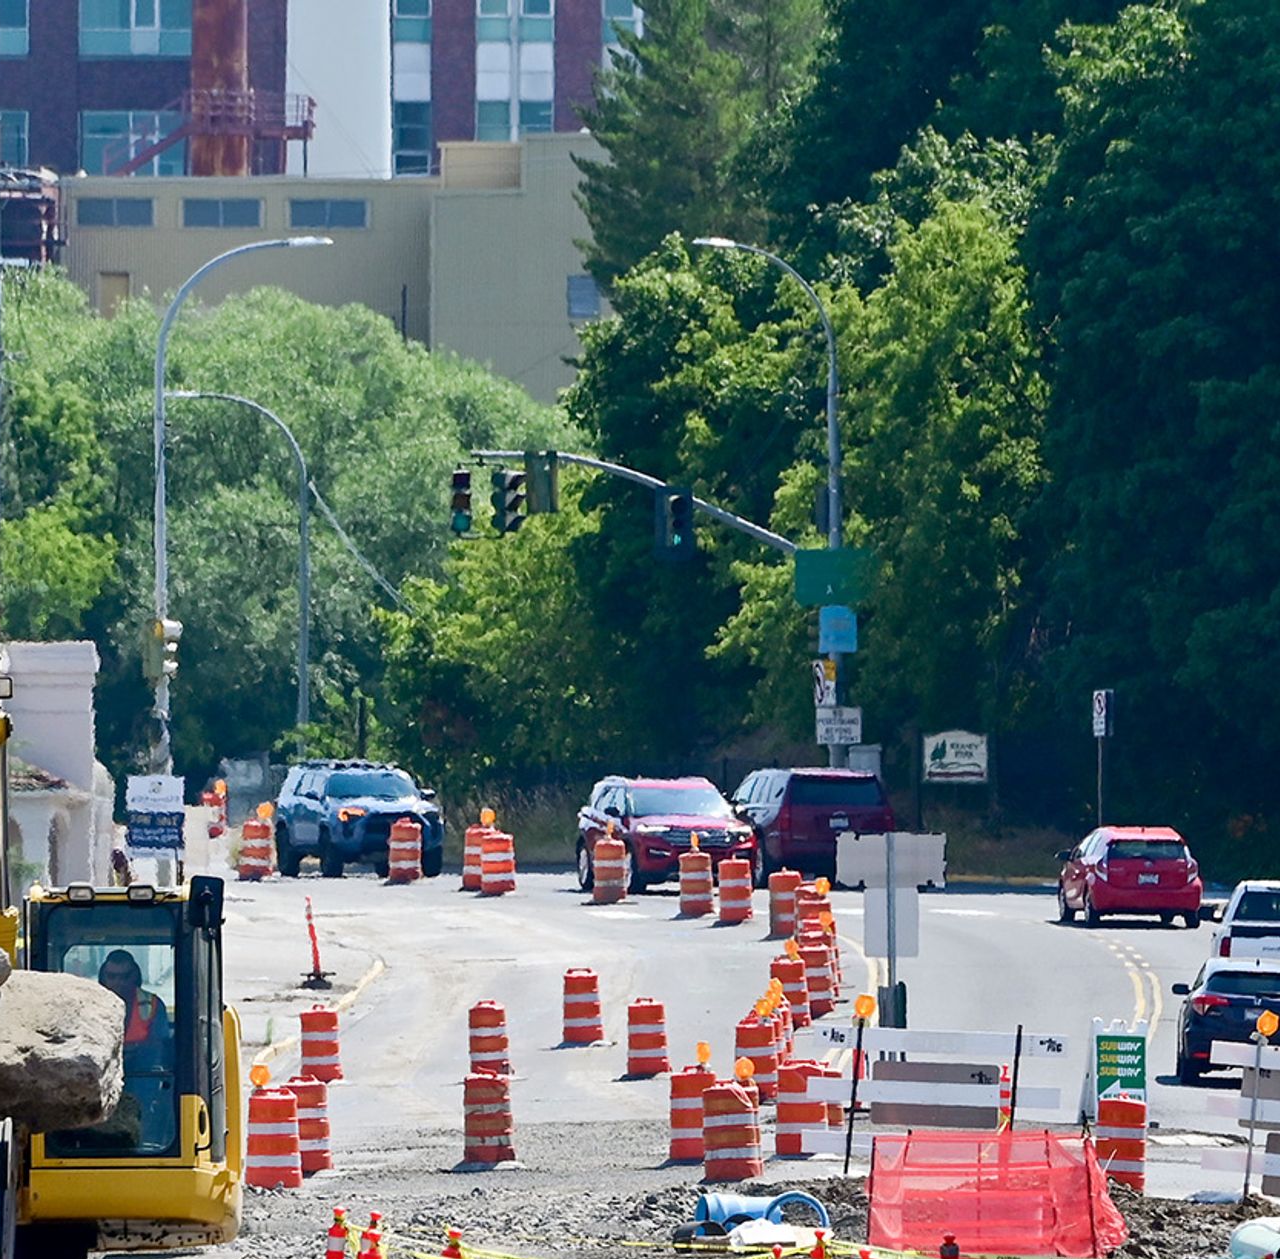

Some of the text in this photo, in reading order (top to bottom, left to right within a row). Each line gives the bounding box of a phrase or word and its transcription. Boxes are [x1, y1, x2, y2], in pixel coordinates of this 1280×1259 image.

[1100, 1042, 1141, 1050] SUBWAY
[1100, 1055, 1141, 1064] SUBWAY
[1100, 1068, 1141, 1077] SUBWAY
